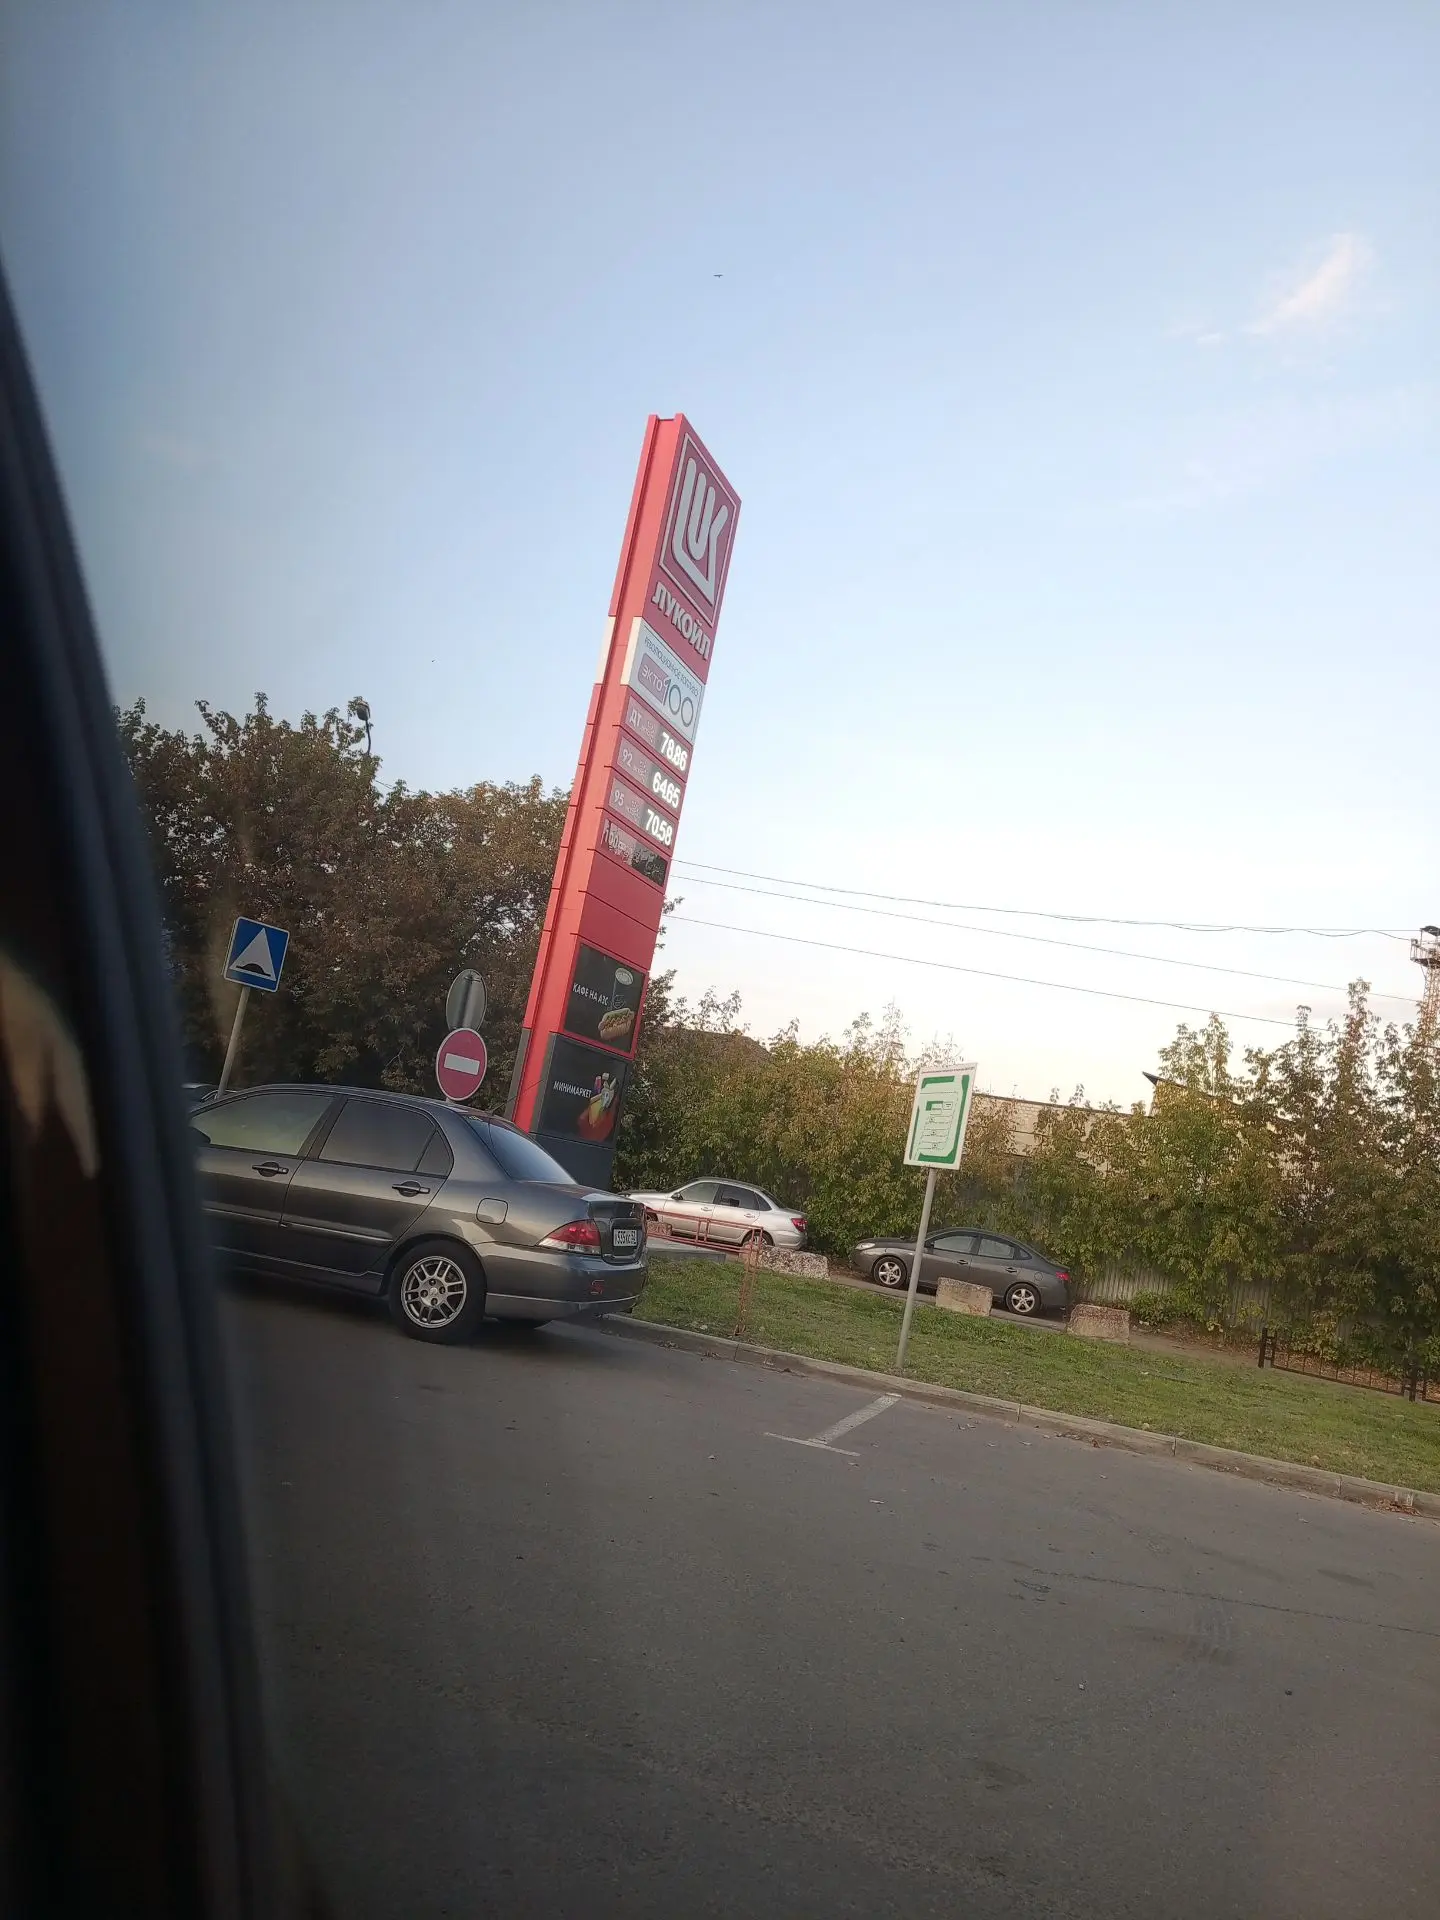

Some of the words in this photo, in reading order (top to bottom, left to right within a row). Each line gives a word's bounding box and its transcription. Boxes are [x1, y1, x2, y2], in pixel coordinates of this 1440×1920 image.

[651, 581, 711, 661] ЛУКОЙЛ
[642, 664, 663, 691] ЭКТО
[663, 679, 694, 727] 100
[630, 708, 642, 727] ДТ
[622, 748, 633, 767] 92
[614, 790, 625, 806] 95
[573, 982, 589, 997] КАФЕ
[589, 989, 598, 1001] НА
[597, 994, 609, 1006] АЗС
[553, 1081, 592, 1098] МИНИМАРКЕТ
